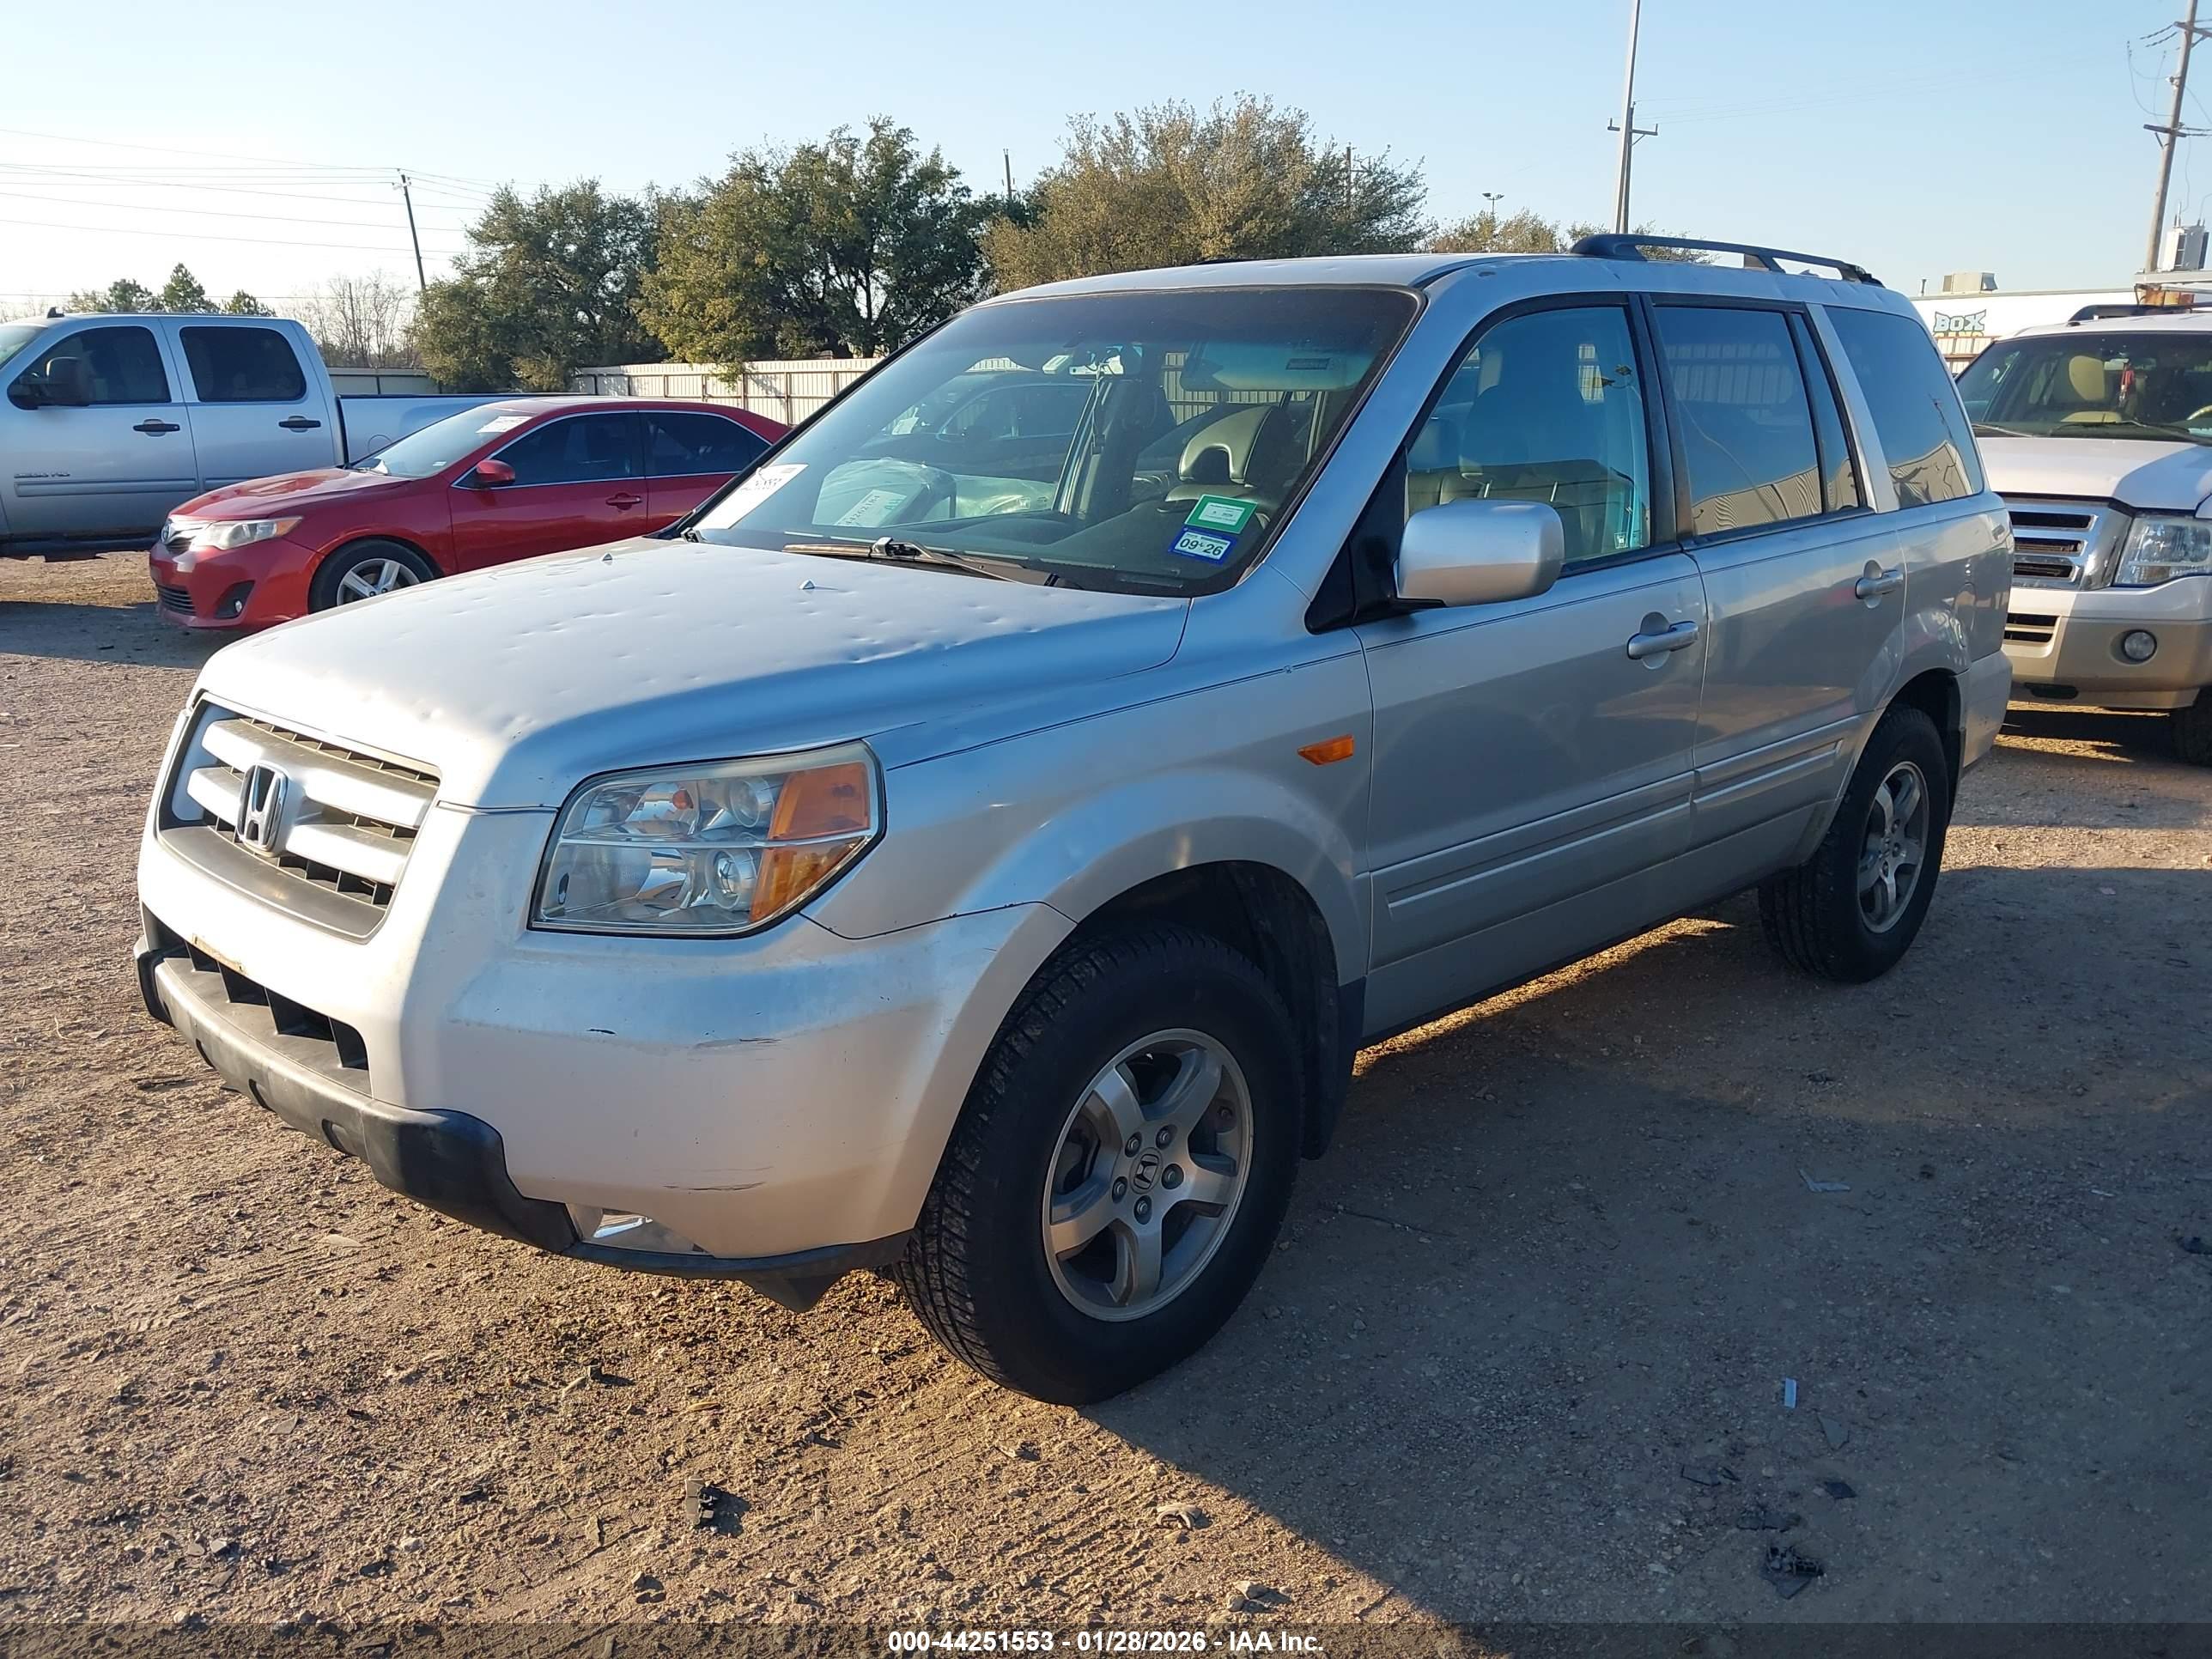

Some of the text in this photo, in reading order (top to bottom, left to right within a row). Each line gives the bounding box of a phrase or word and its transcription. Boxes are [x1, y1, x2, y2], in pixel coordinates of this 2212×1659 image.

[1933, 309, 1987, 332] BOX
[1180, 538, 1200, 550] 09
[1203, 544, 1224, 556] 26
